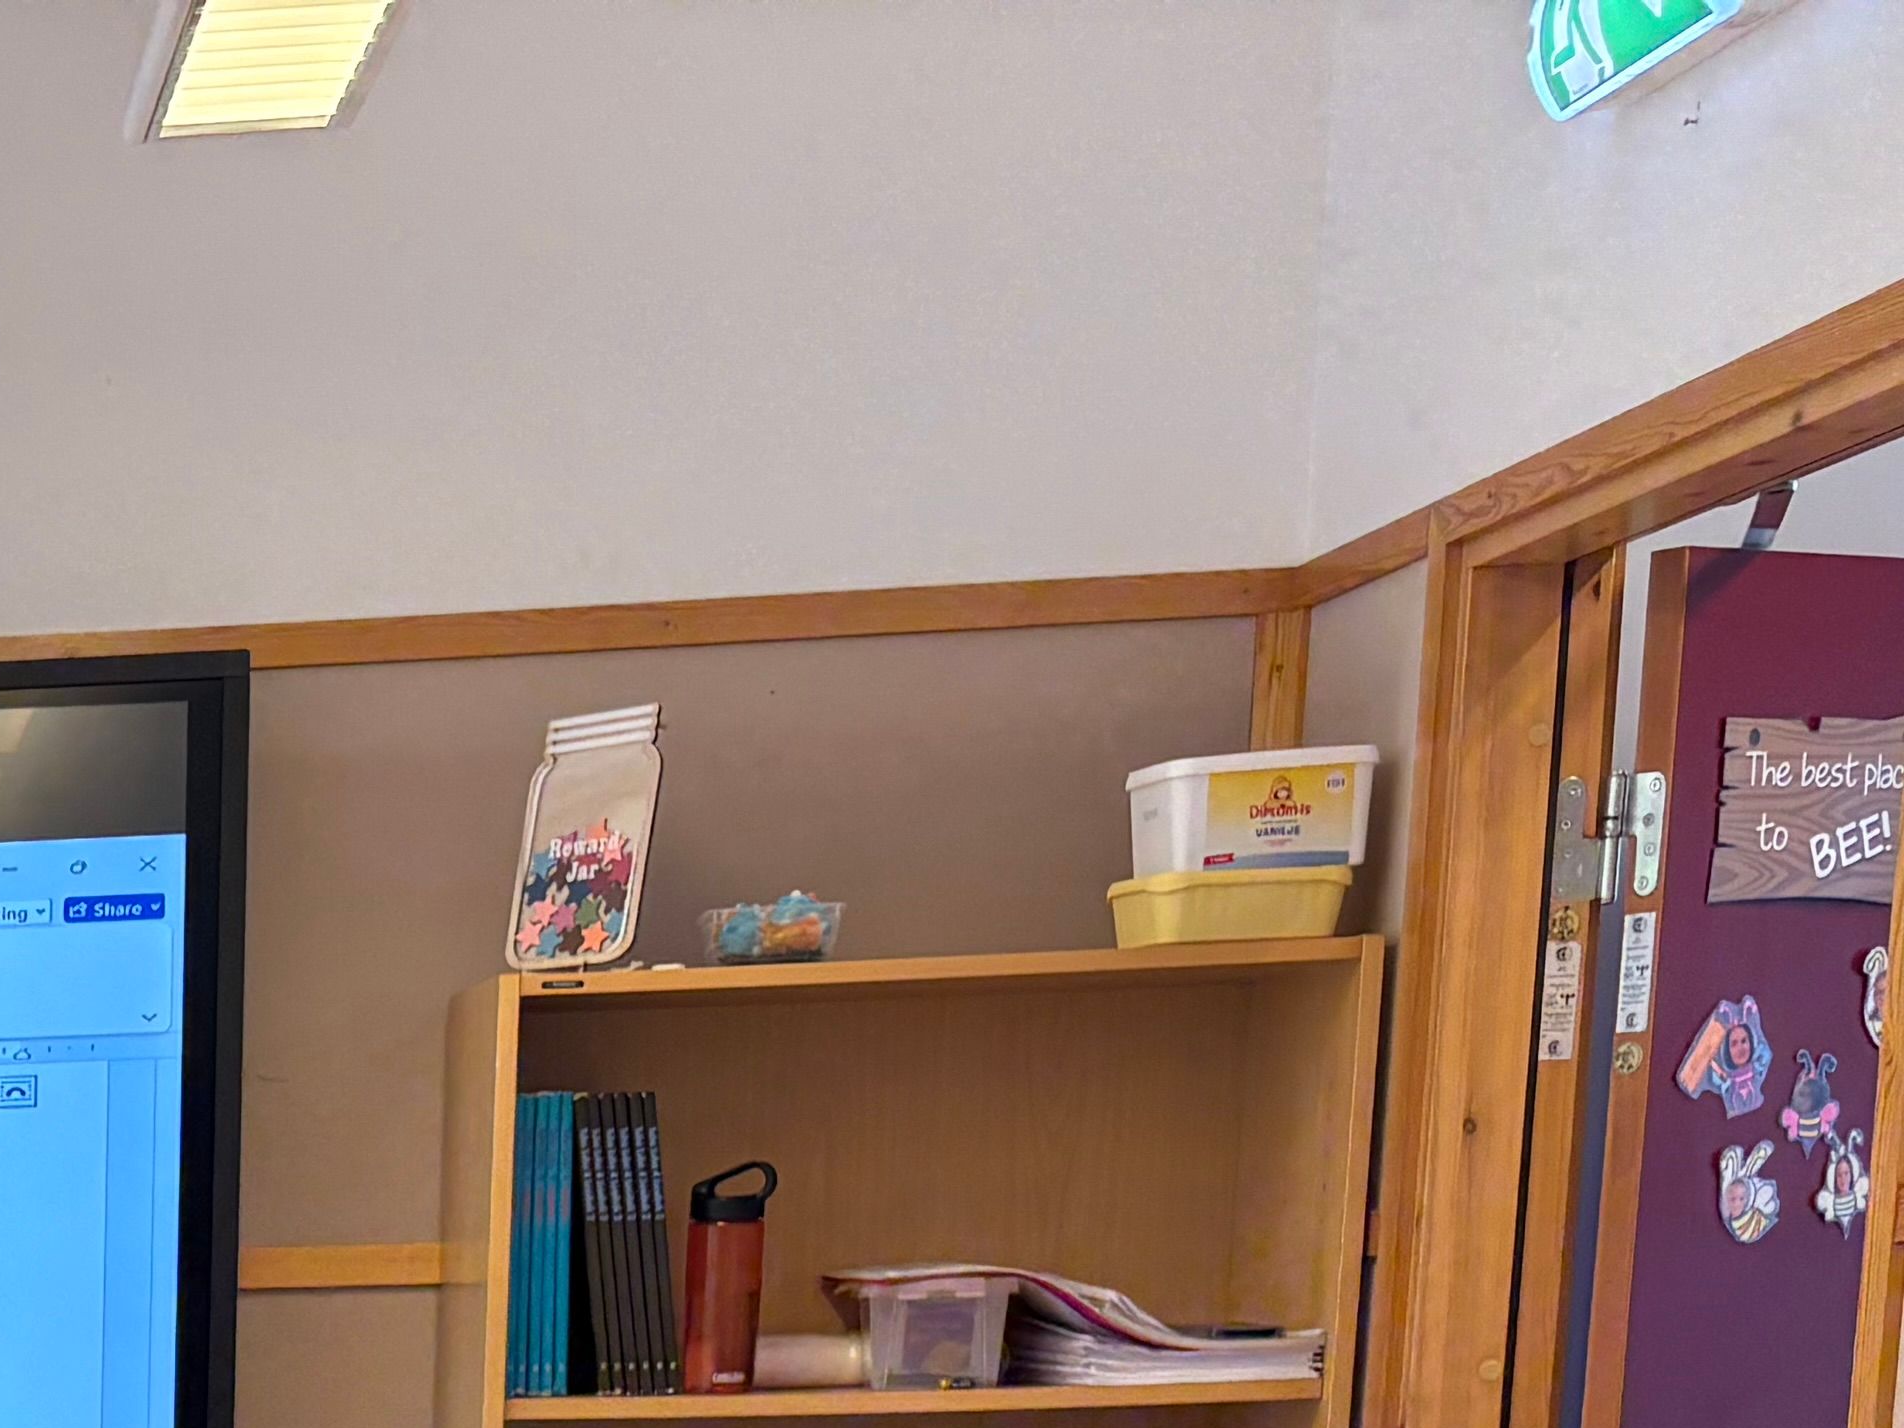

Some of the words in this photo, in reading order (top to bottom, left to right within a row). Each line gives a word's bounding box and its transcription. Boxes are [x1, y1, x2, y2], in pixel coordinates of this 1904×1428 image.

[1746, 750, 1793, 787] The
[1800, 752, 1860, 788] best
[1756, 812, 1789, 851] to
[1809, 810, 1892, 879] BEE!
[566, 861, 600, 882] Jar
[93, 902, 143, 918] Share
